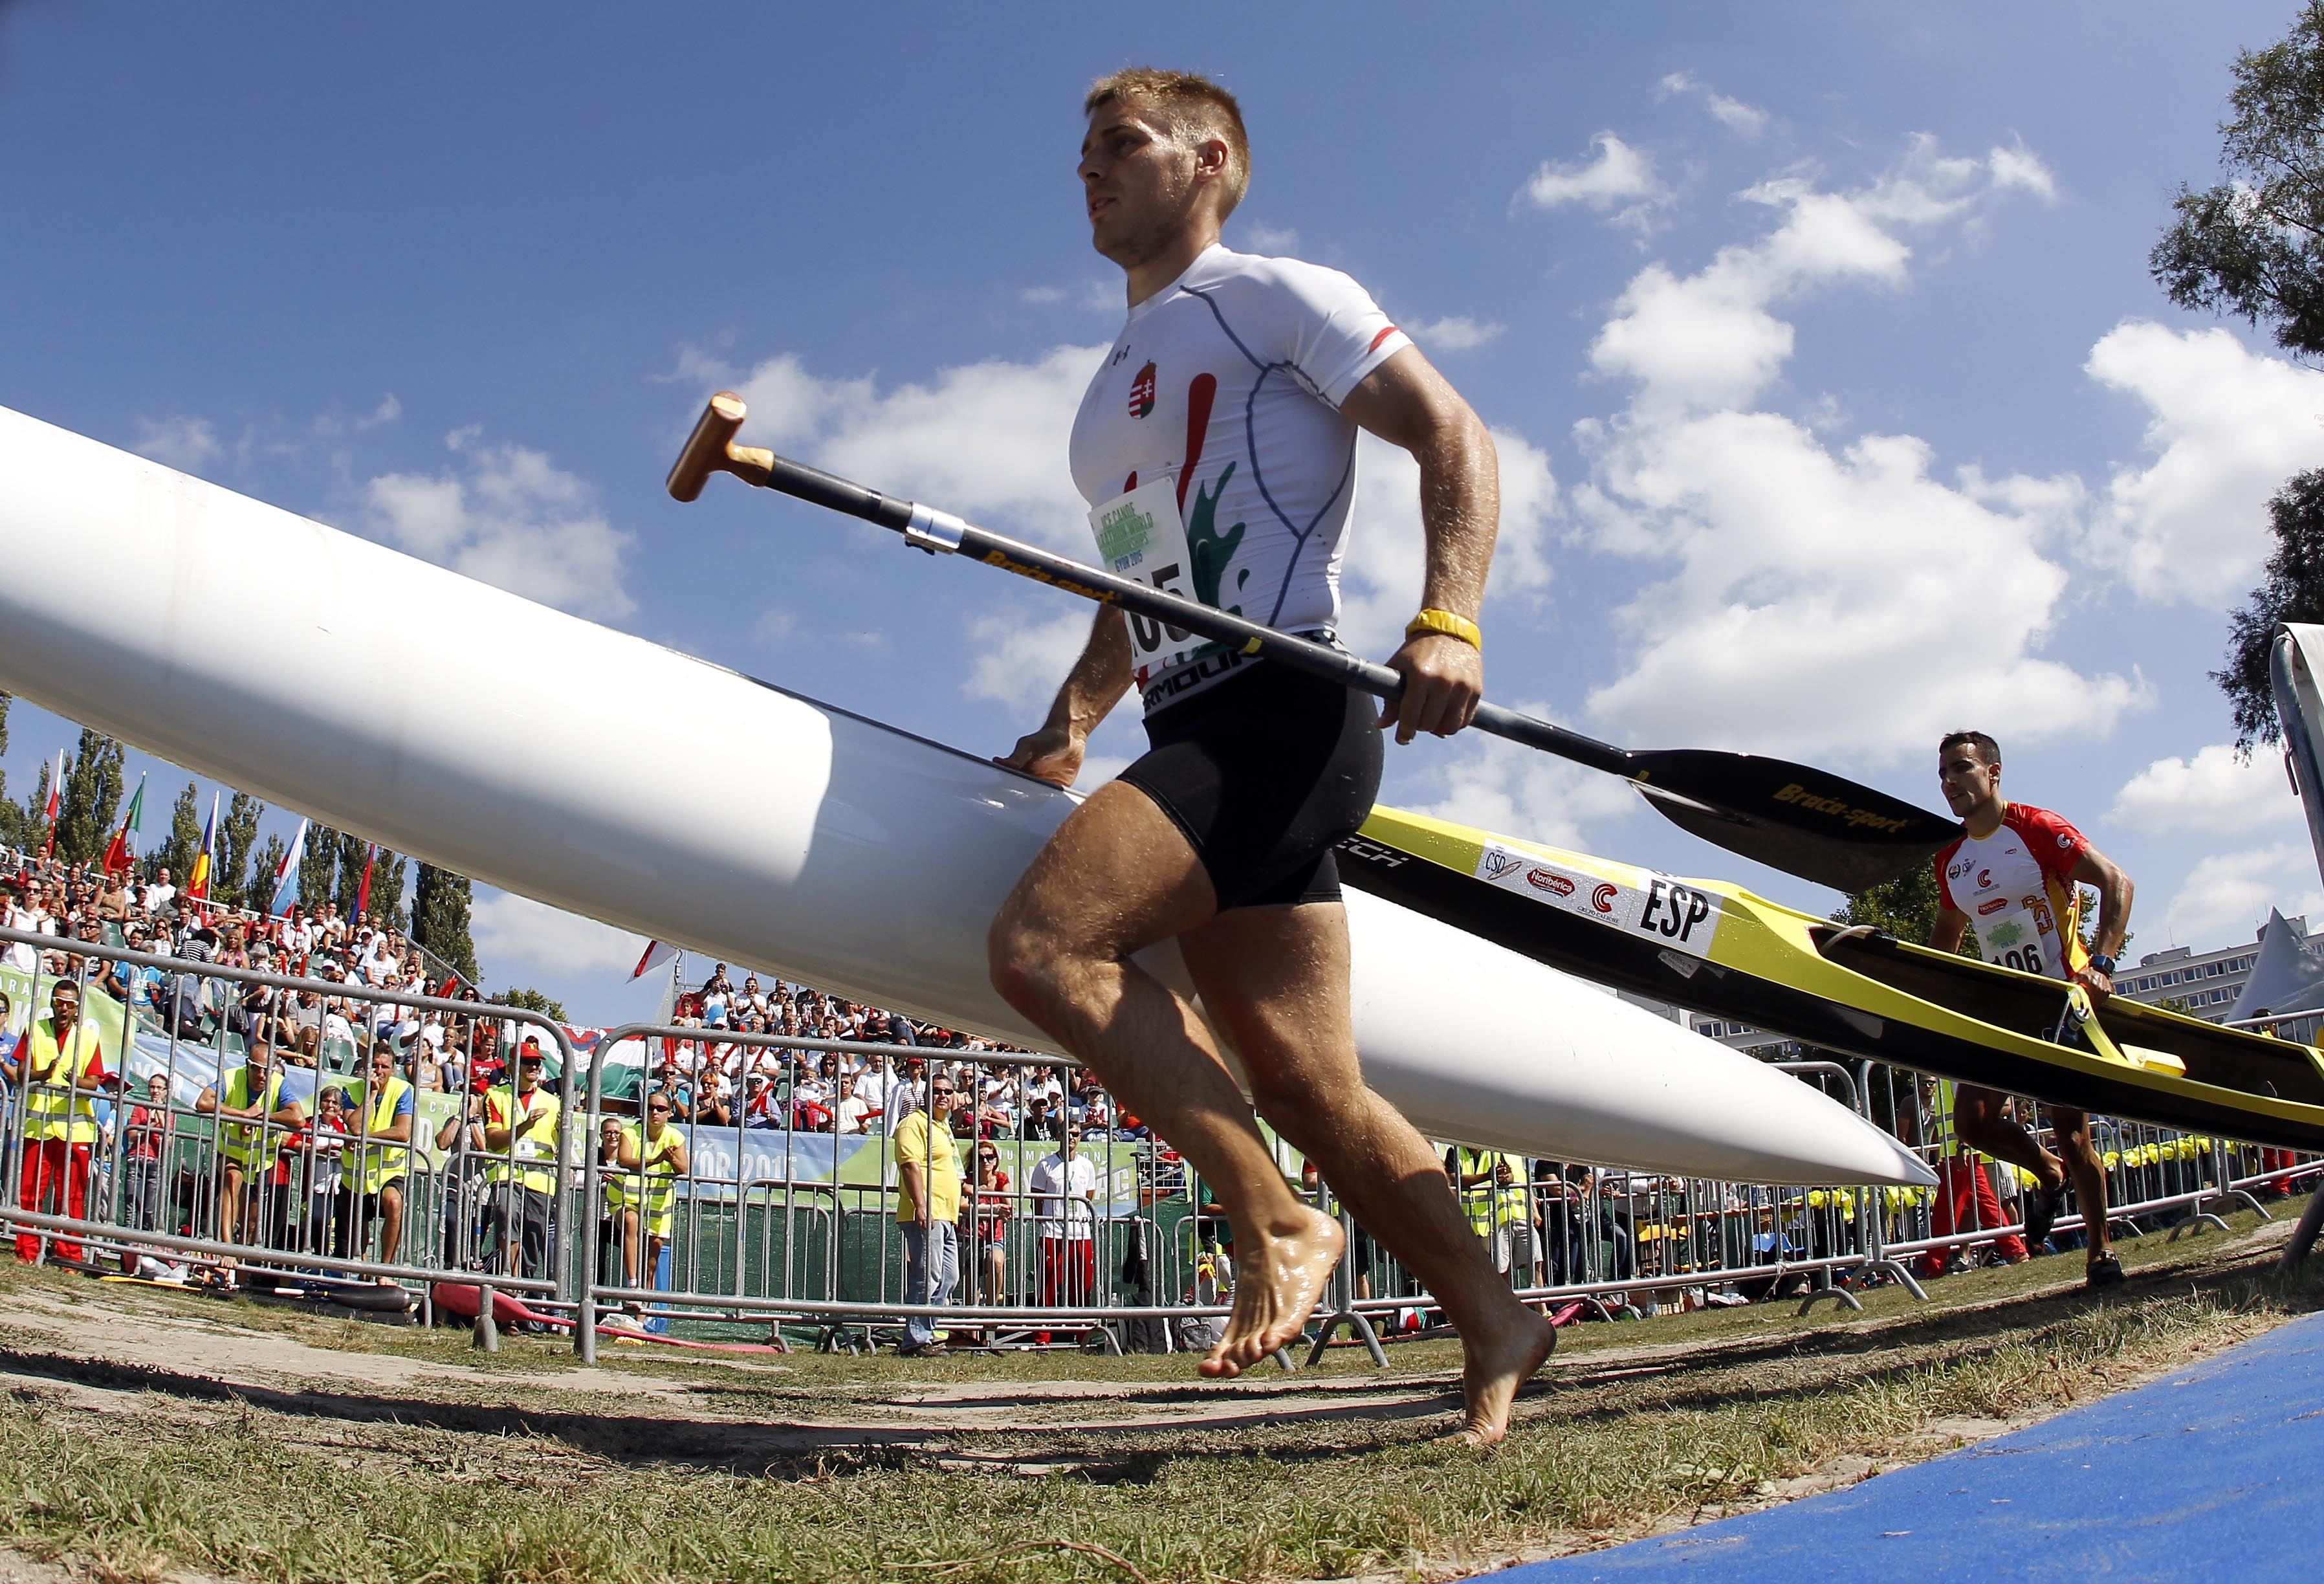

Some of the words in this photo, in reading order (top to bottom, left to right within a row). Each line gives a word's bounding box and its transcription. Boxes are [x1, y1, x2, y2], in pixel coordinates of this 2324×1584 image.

[1485, 852, 1506, 874] CSD
[1531, 871, 1572, 892] Noribérica
[1639, 879, 1709, 943] ESP
[2021, 895, 2054, 936] ESP
[742, 1153, 798, 1182] 2015
